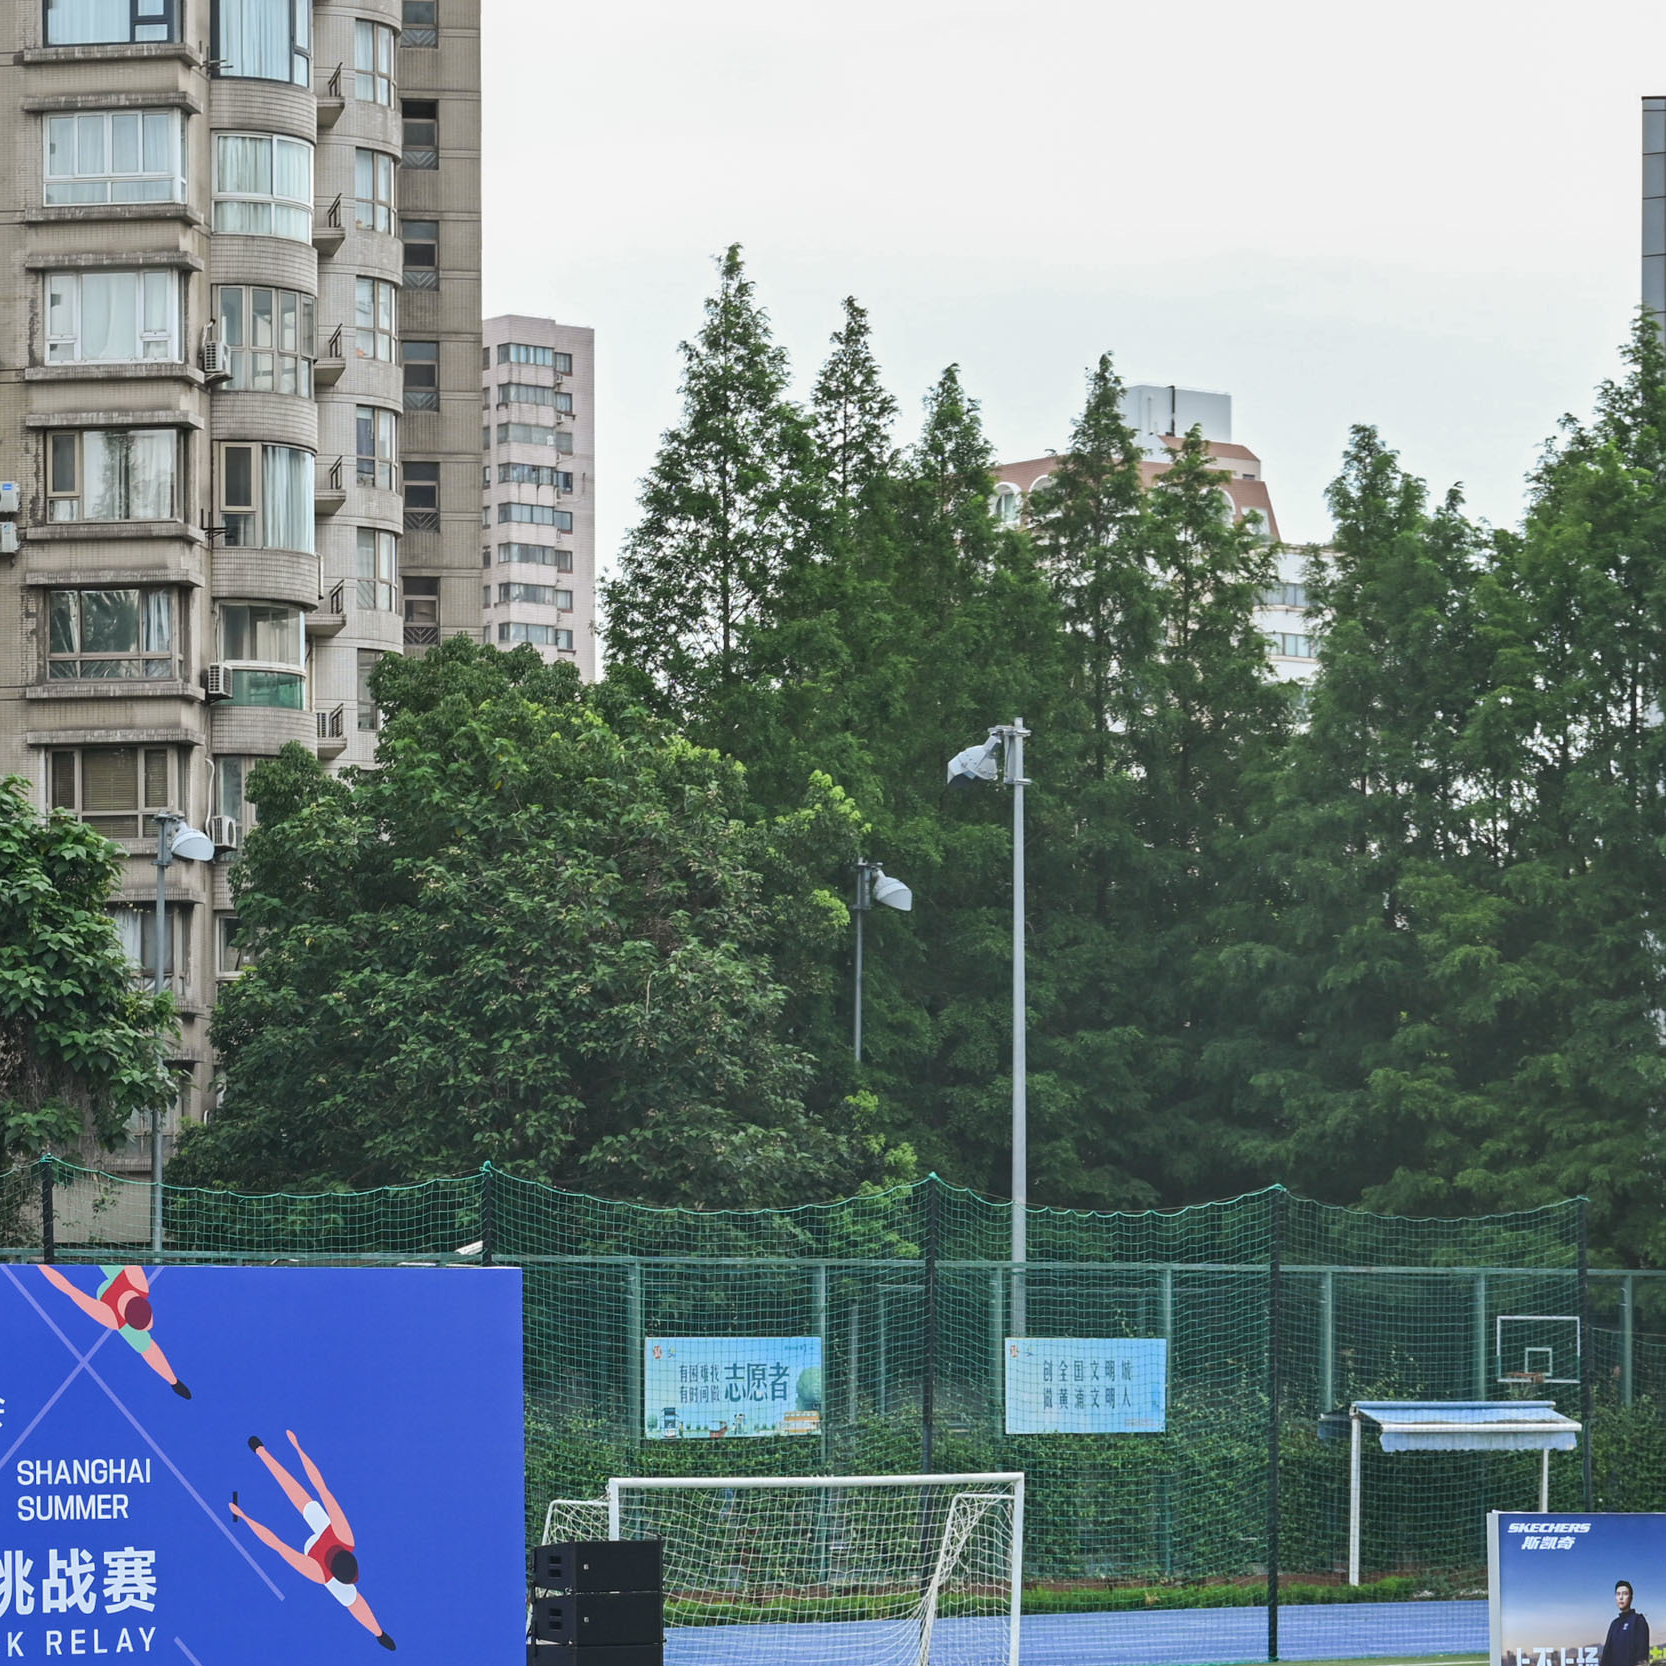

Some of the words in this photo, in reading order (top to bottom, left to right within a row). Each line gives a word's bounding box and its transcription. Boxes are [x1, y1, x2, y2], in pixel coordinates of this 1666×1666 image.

[724, 1362, 790, 1402] 志愿者
[17, 1457, 152, 1487] SHANGHAI
[17, 1493, 130, 1522] SUMMER
[1508, 1522, 1591, 1533] SKECHERS
[1521, 1535, 1575, 1550] 斯凯奇
[45, 1626, 157, 1656] RELAY
